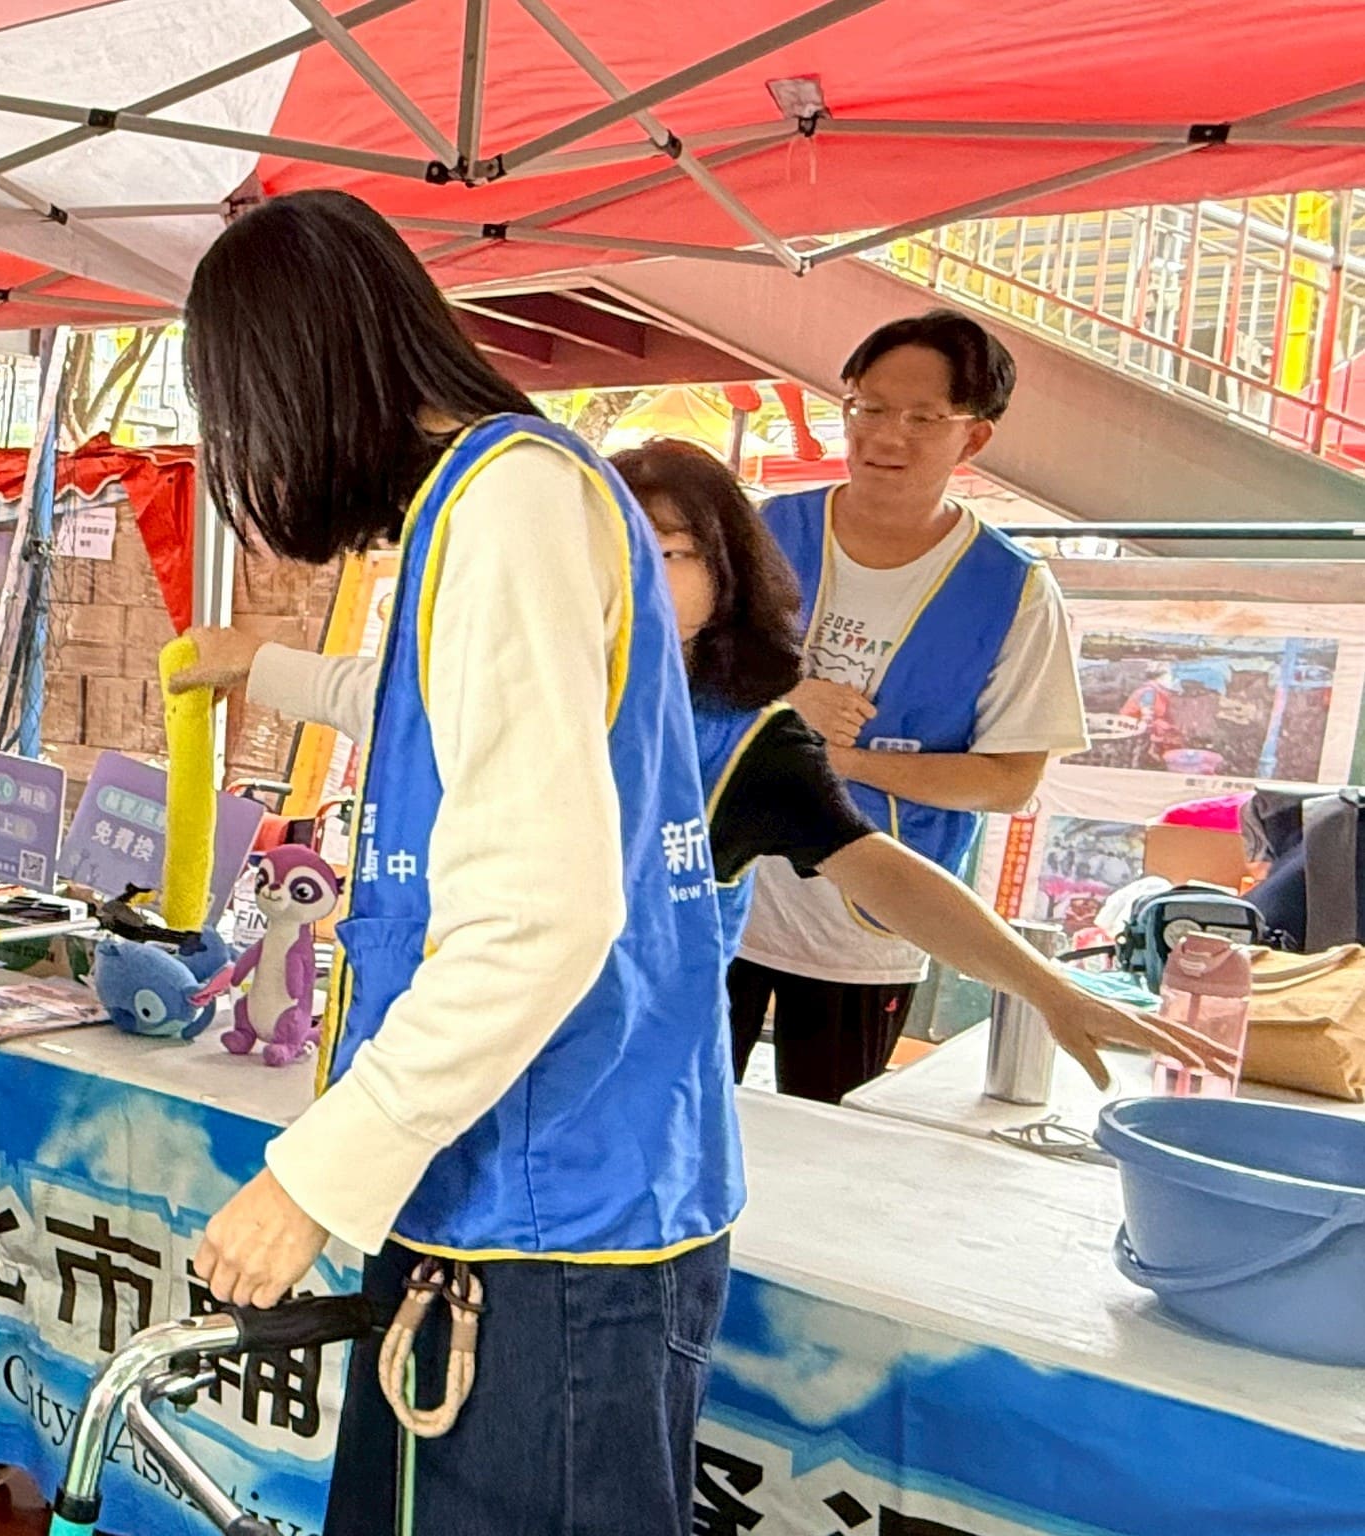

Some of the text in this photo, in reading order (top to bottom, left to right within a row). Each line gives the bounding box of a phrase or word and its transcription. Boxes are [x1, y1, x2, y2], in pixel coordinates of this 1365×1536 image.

[823, 612, 866, 634] 2022
[91, 820, 155, 862] 免費換
[668, 884, 702, 903] New
[3, 1354, 77, 1446] City
